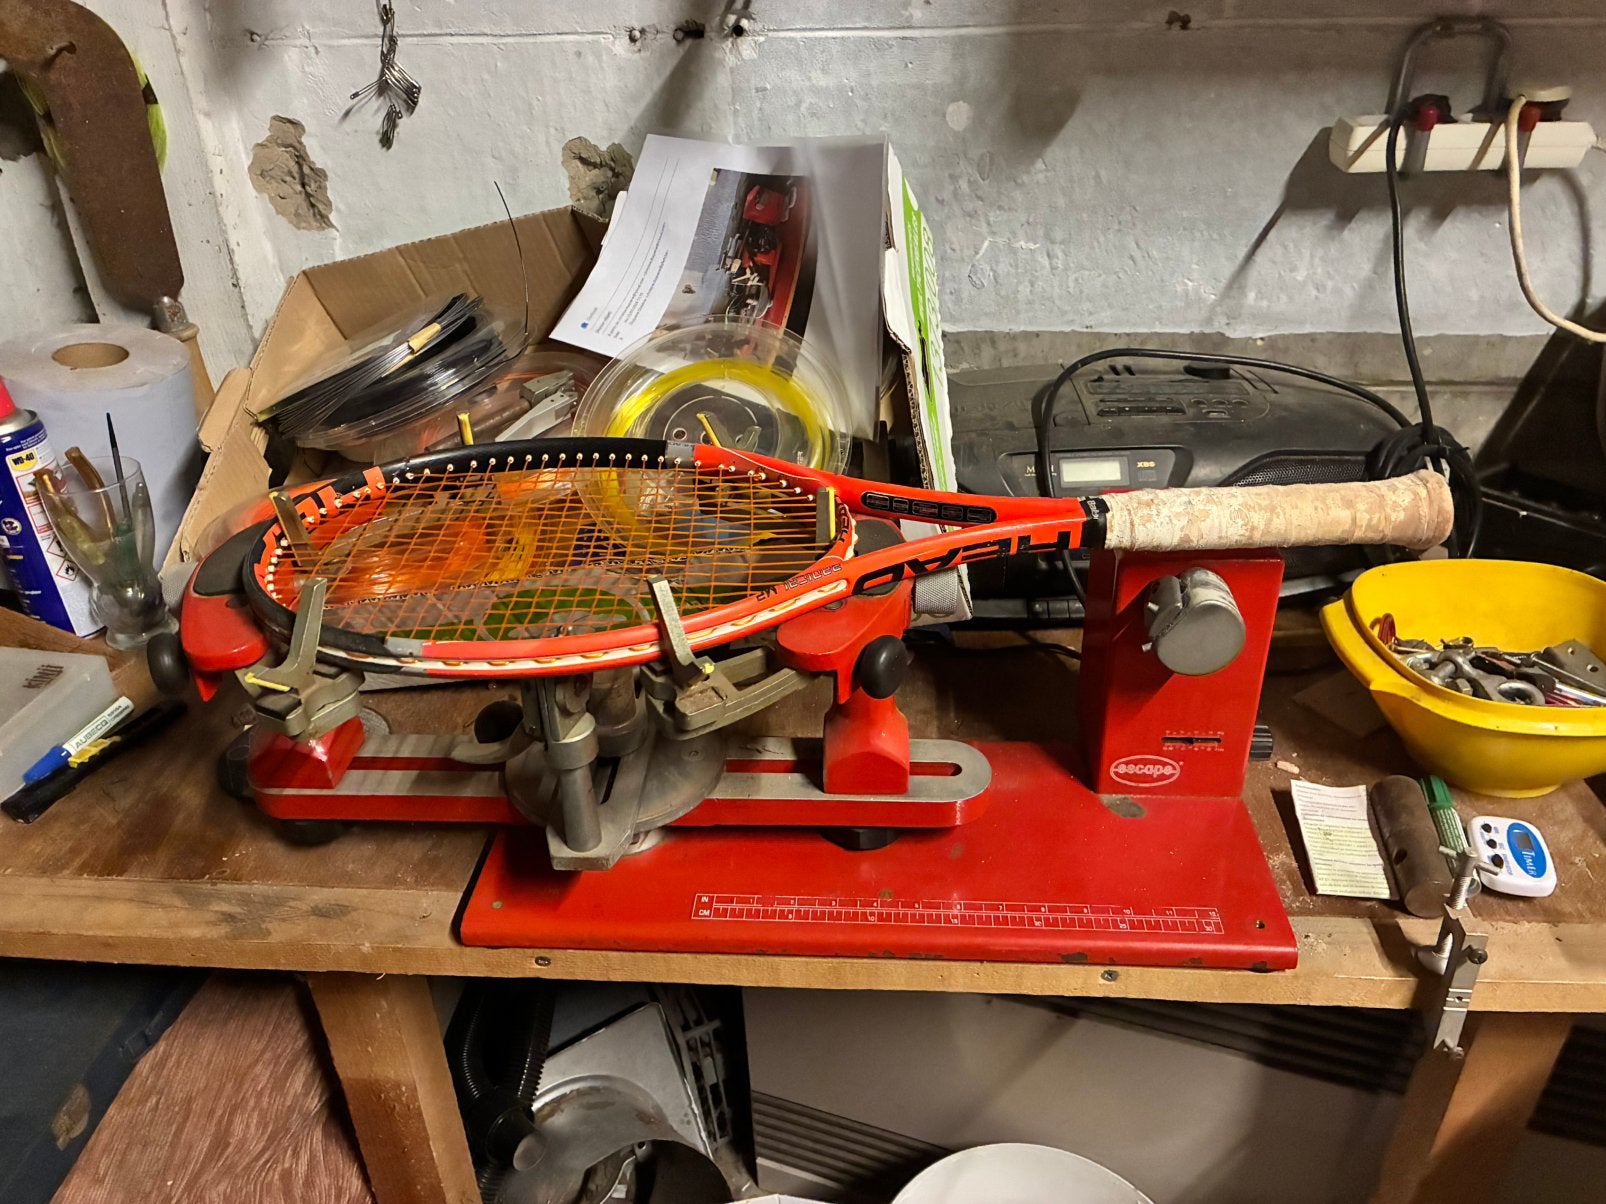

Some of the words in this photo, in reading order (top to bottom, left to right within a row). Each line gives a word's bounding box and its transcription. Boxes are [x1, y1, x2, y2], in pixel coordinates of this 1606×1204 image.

[12, 452, 35, 466] WD-40
[852, 531, 1072, 595] HEAD
[1117, 763, 1174, 778] escape
